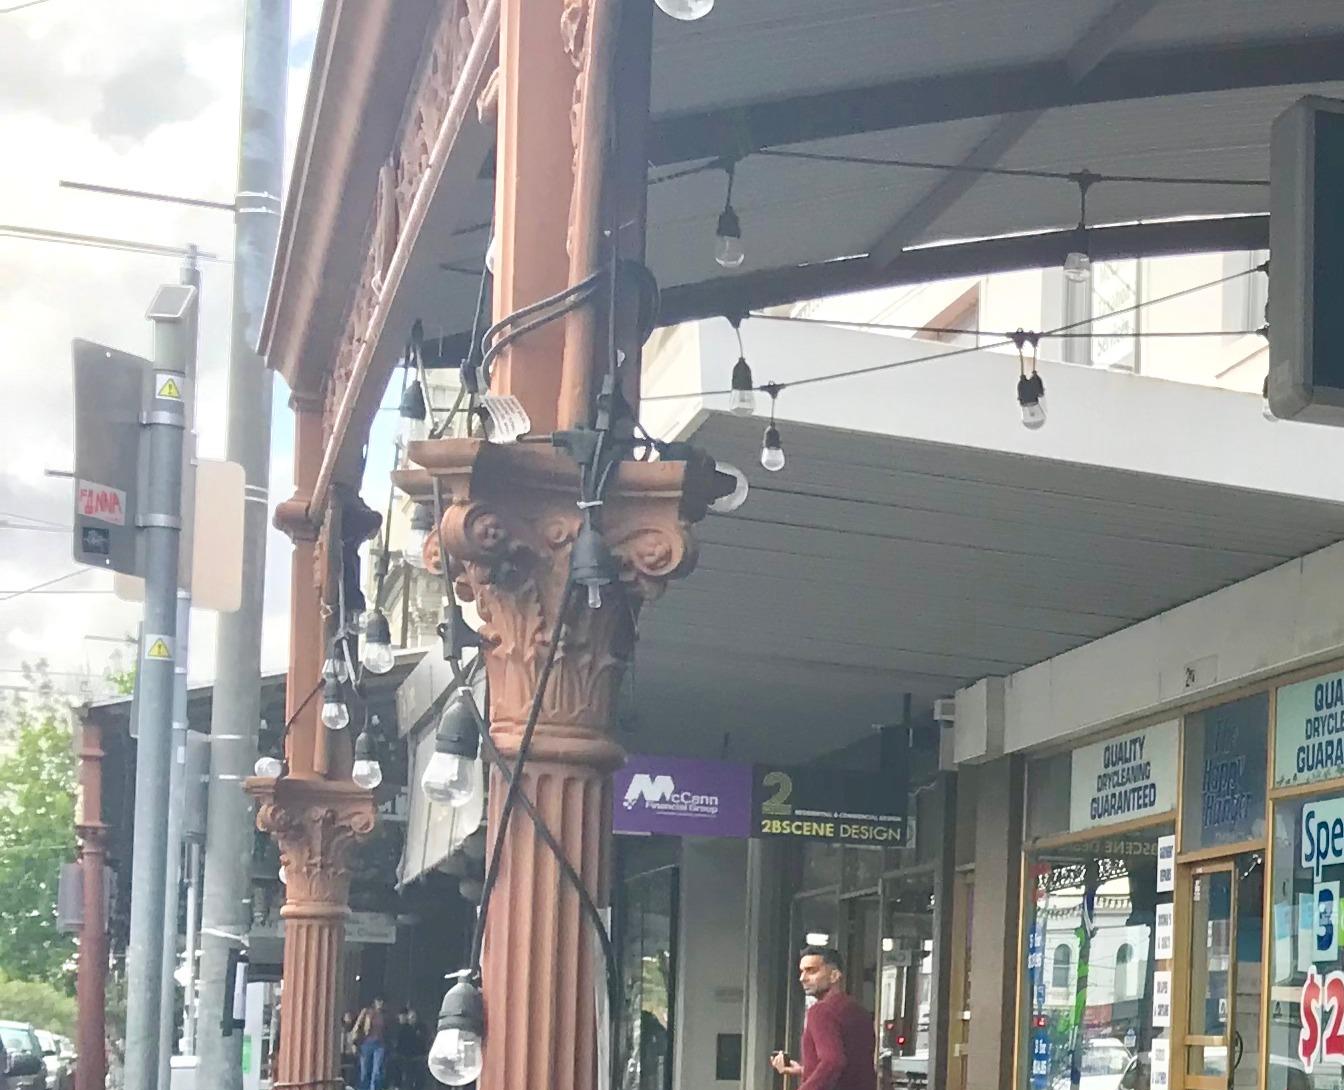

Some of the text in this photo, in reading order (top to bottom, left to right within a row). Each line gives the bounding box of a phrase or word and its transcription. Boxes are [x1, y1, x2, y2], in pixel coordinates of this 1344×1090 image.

[1103, 735, 1146, 770] QUALITY
[761, 771, 793, 815] 2
[1096, 760, 1152, 793] DRYCLEANING
[688, 803, 719, 815] Group
[1089, 782, 1157, 821] GUARANTEED
[761, 819, 902, 842] 2BSCENE DESIGN
